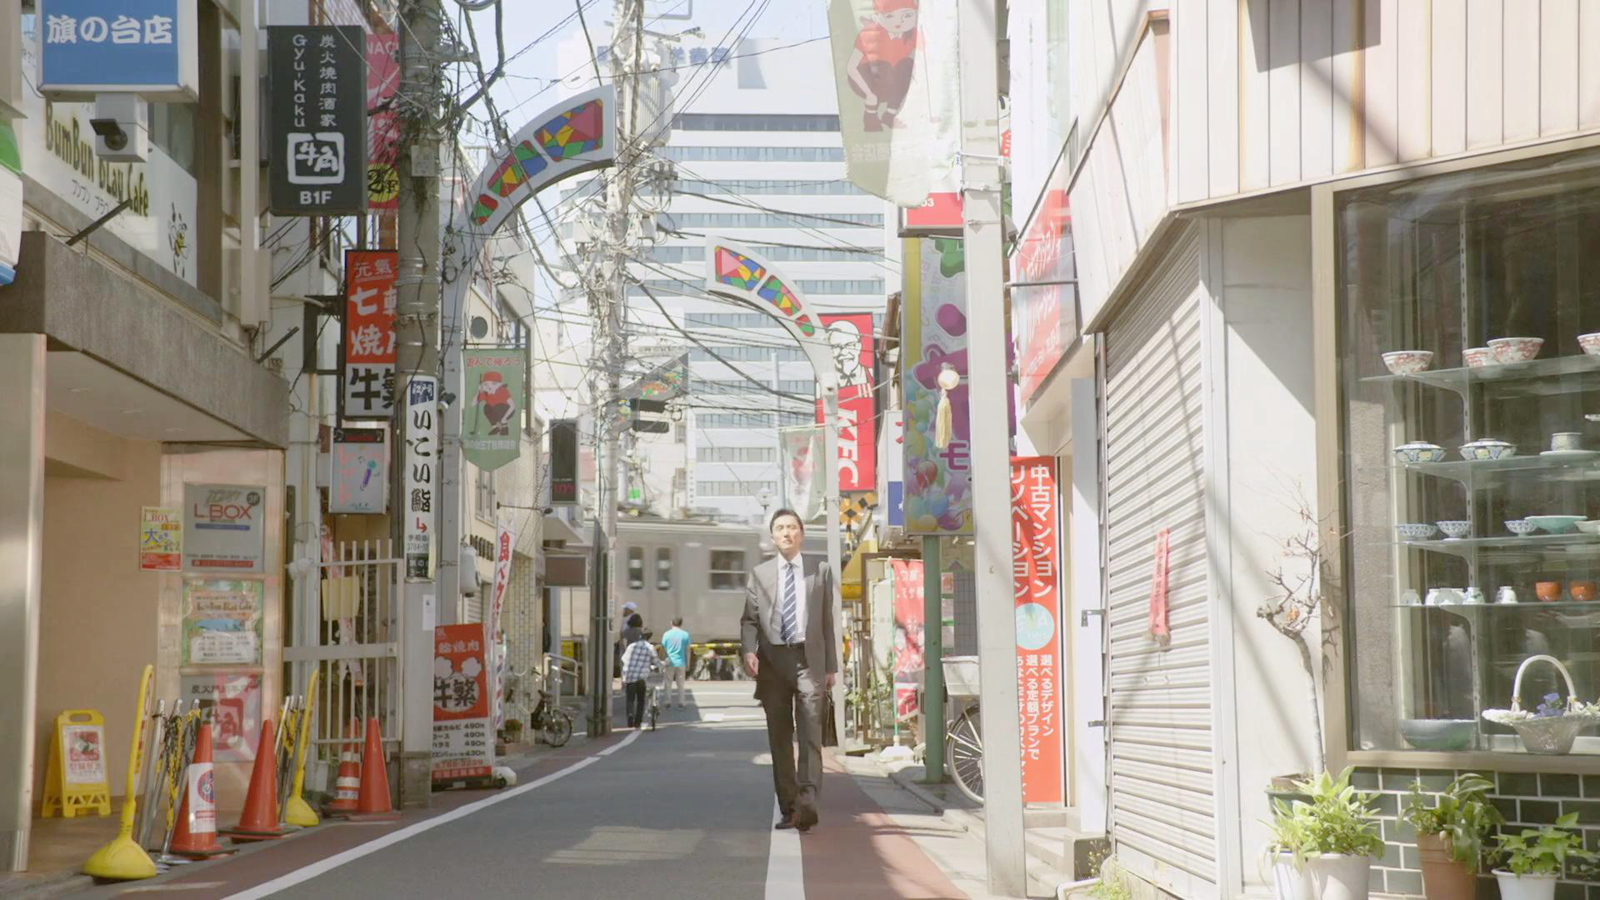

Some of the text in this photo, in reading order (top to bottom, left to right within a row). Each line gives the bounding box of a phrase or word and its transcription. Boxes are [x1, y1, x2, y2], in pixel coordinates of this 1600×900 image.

[46, 14, 173, 44] 旗の台店
[292, 33, 307, 128] Gyu-Kaku
[295, 141, 339, 173] 牛角
[300, 190, 332, 205] B1F
[406, 410, 432, 513] いこい鮨
[837, 408, 859, 487] KFC
[1010, 465, 1029, 598] リノベーション
[1030, 464, 1053, 598] 中古マンション
[1026, 654, 1041, 760] 選べる定額プランで
[1040, 654, 1054, 736] 選べるデザイン
